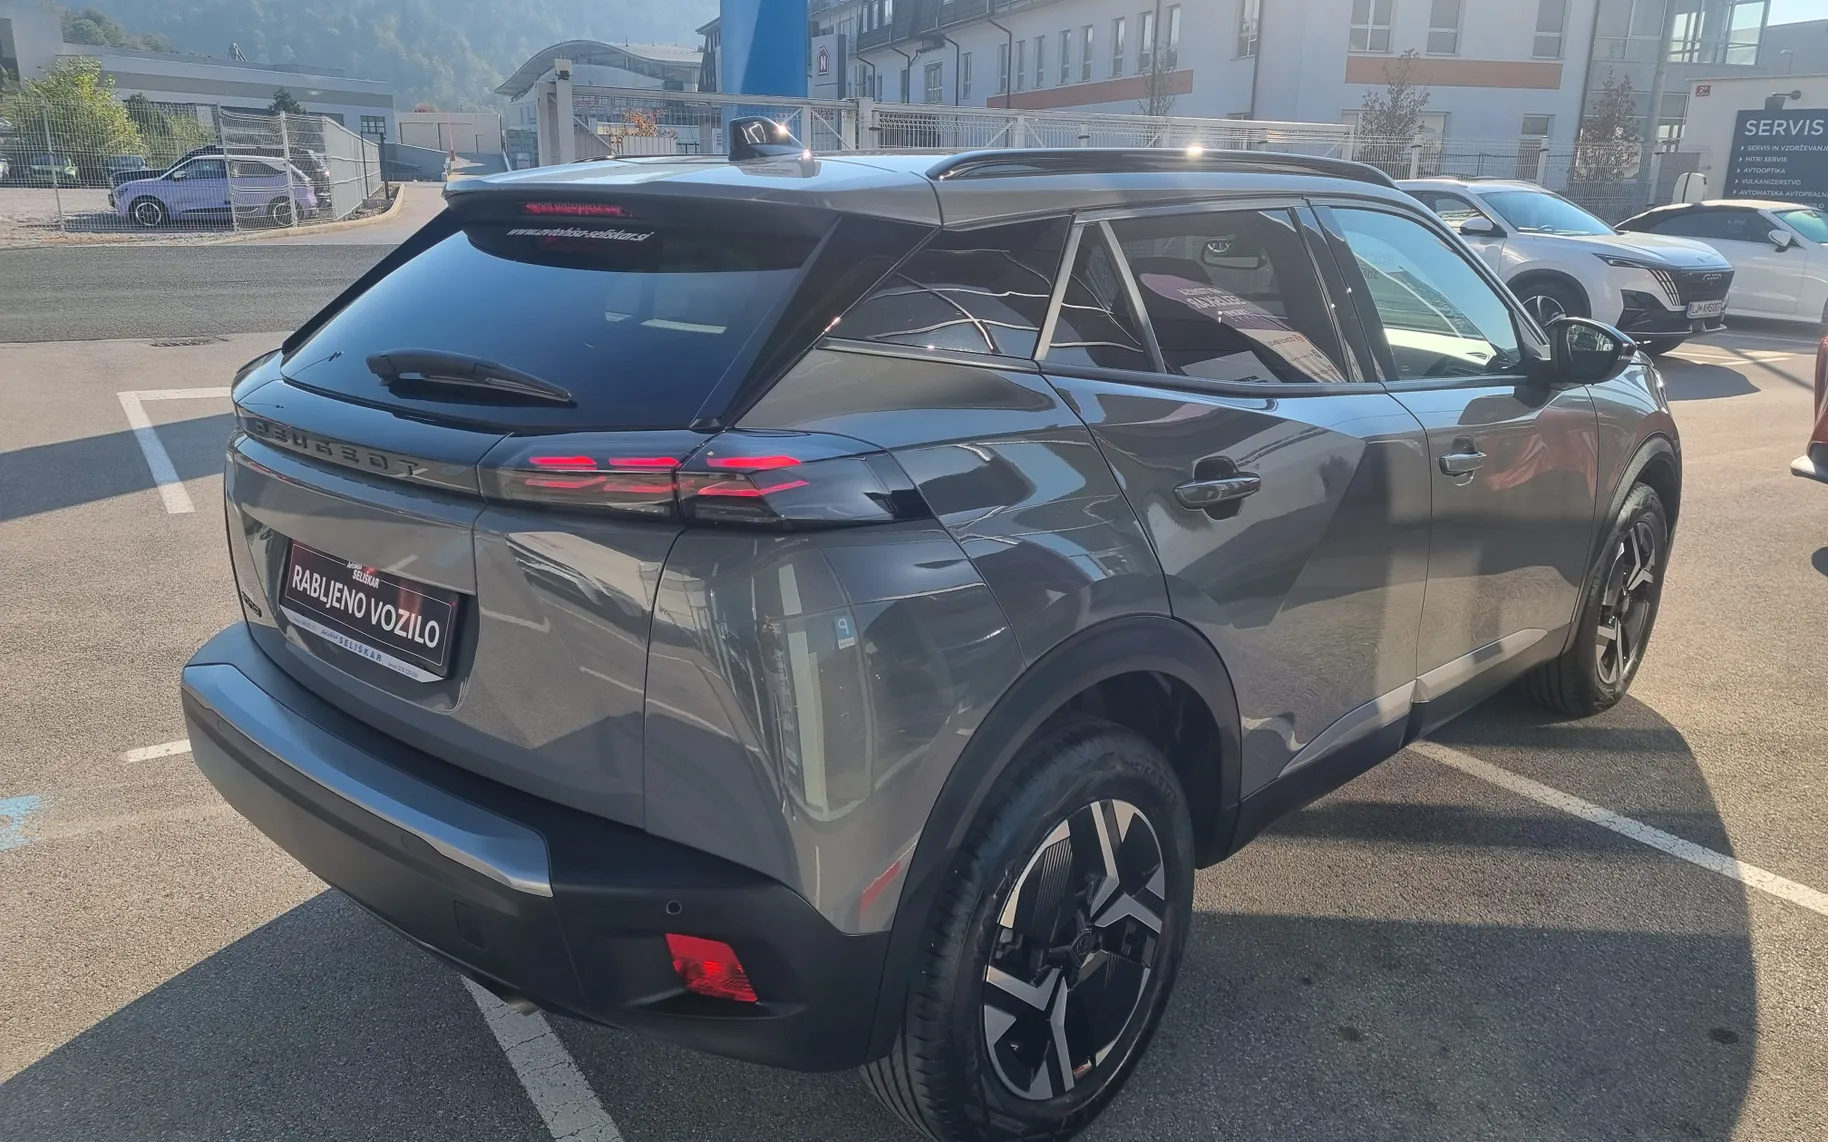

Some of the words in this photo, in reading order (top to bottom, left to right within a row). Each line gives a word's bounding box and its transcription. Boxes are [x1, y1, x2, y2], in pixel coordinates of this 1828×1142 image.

[1744, 119, 1825, 136] SERVIS
[1741, 178, 1801, 186] VULKANIZERSTVO
[255, 421, 420, 476] PEUGEOT
[352, 569, 380, 590] SELIŠKAR
[291, 564, 366, 619] RABLJENO
[371, 597, 440, 649] VOZILO
[338, 635, 382, 663] SELIŠKAR
